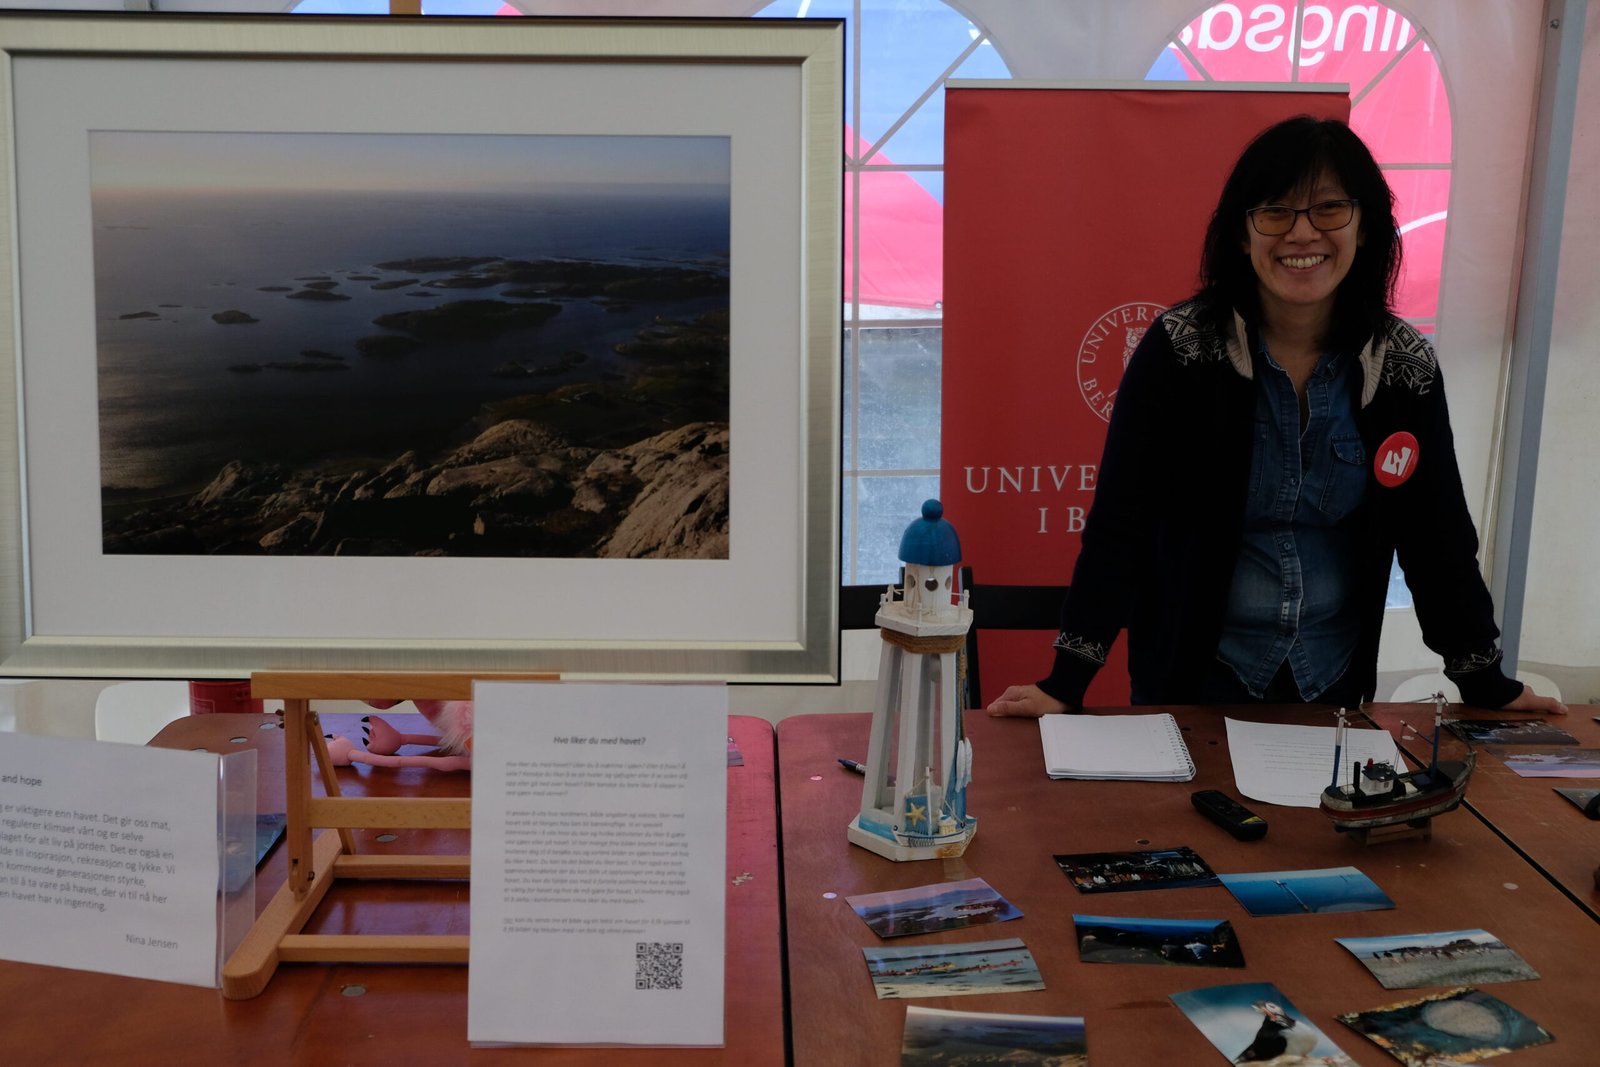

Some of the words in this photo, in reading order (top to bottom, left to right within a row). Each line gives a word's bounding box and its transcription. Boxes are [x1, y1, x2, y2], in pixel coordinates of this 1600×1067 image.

[1083, 378, 1114, 418] BER
[963, 464, 1097, 494] UNIVE
[1037, 507, 1049, 534] I
[1066, 506, 1087, 533] B
[553, 736, 569, 745] Hva
[570, 736, 588, 745] liker
[588, 736, 599, 745] du
[600, 737, 618, 745] med
[619, 736, 647, 746] havet?
[2, 774, 18, 784] and
[20, 775, 43, 787] hope
[4, 804, 14, 813] er
[16, 804, 54, 818] viktigere
[54, 809, 72, 818] enn
[102, 814, 118, 825] Det
[120, 816, 132, 828] gir
[134, 819, 149, 828] oss
[43, 821, 75, 834] klimaet
[97, 830, 109, 840] og
[110, 831, 120, 839] er
[121, 831, 144, 842] selve
[24, 833, 37, 844] for
[63, 838, 75, 850] på
[110, 844, 127, 855] Det
[128, 848, 138, 856] er
[162, 852, 175, 860] en
[6, 861, 55, 875] kommende
[76, 855, 123, 870] rekreasjon
[125, 862, 137, 873] og
[166, 864, 176, 875] Vi
[28, 879, 37, 888] ta
[60, 882, 71, 892] på
[101, 887, 116, 898] der
[118, 891, 127, 899] vi
[139, 892, 151, 902] nå
[126, 934, 146, 946] Nina
[147, 937, 179, 950] Jensen
